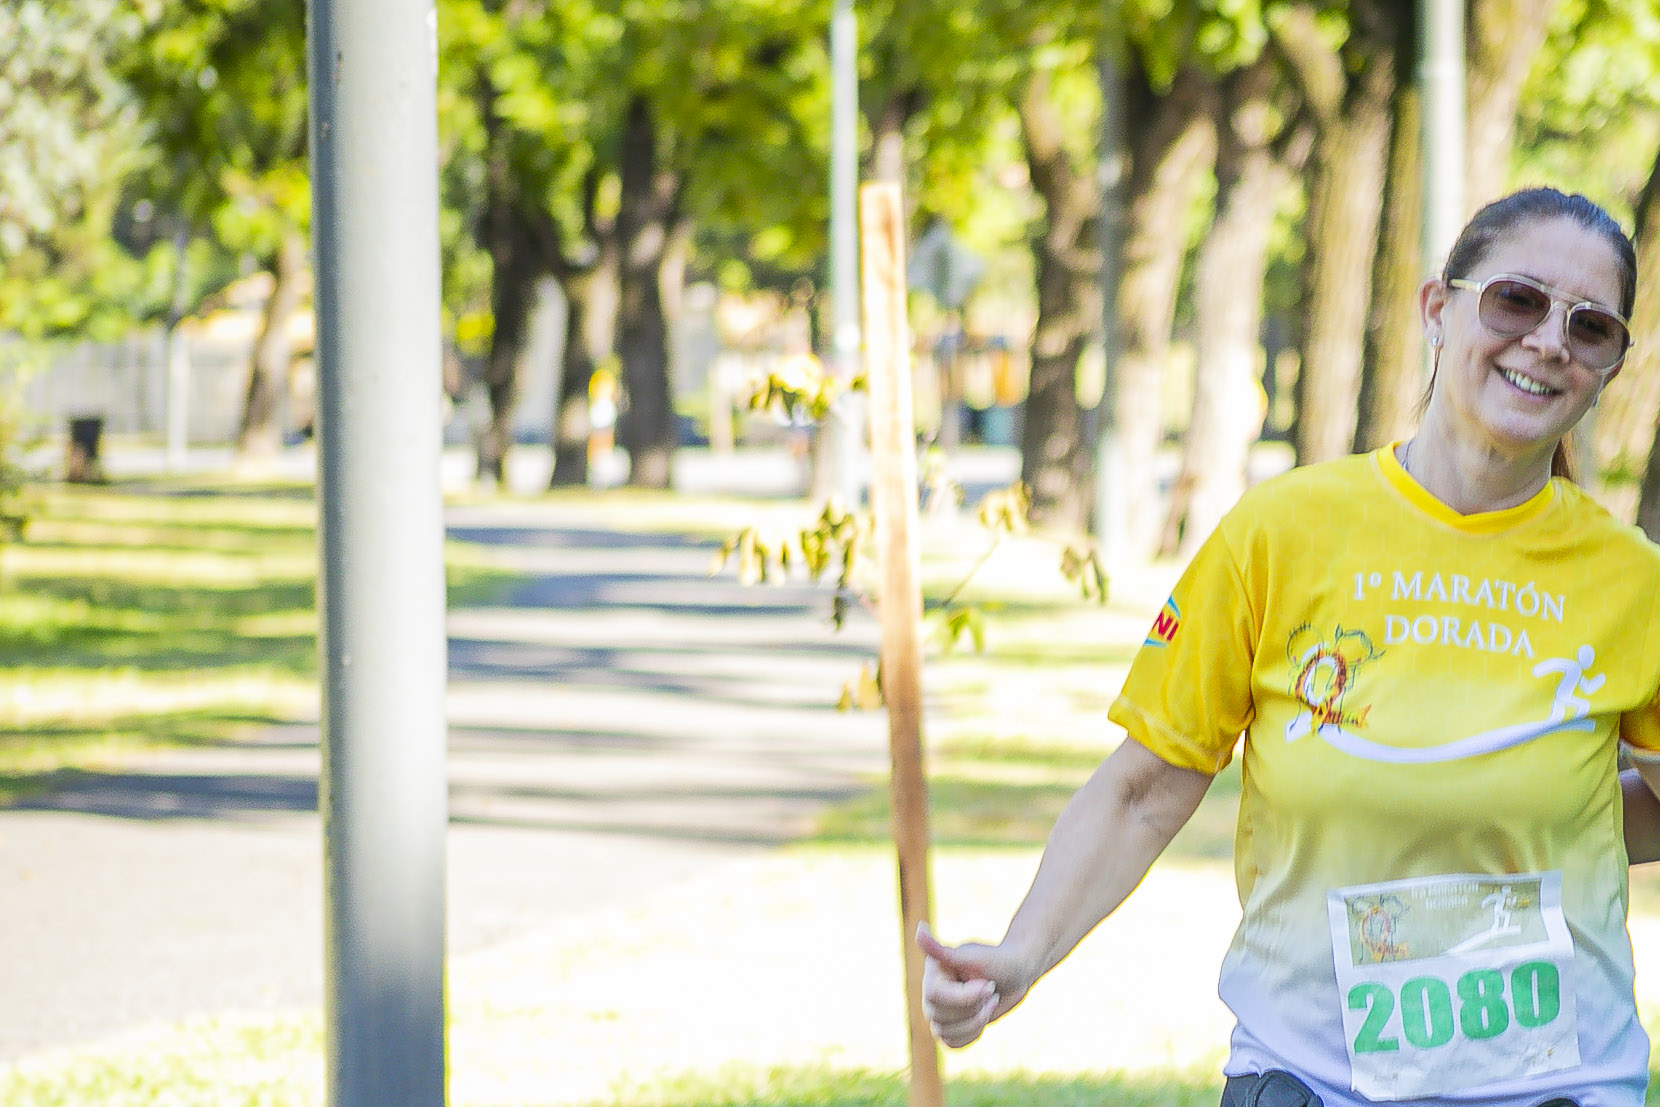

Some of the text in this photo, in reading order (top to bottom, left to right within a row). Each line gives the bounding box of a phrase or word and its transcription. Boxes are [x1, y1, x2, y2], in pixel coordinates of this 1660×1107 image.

[1391, 570, 1565, 623] MARATÓN
[1384, 614, 1535, 659] DORADA
[1347, 961, 1560, 1055] 2080
